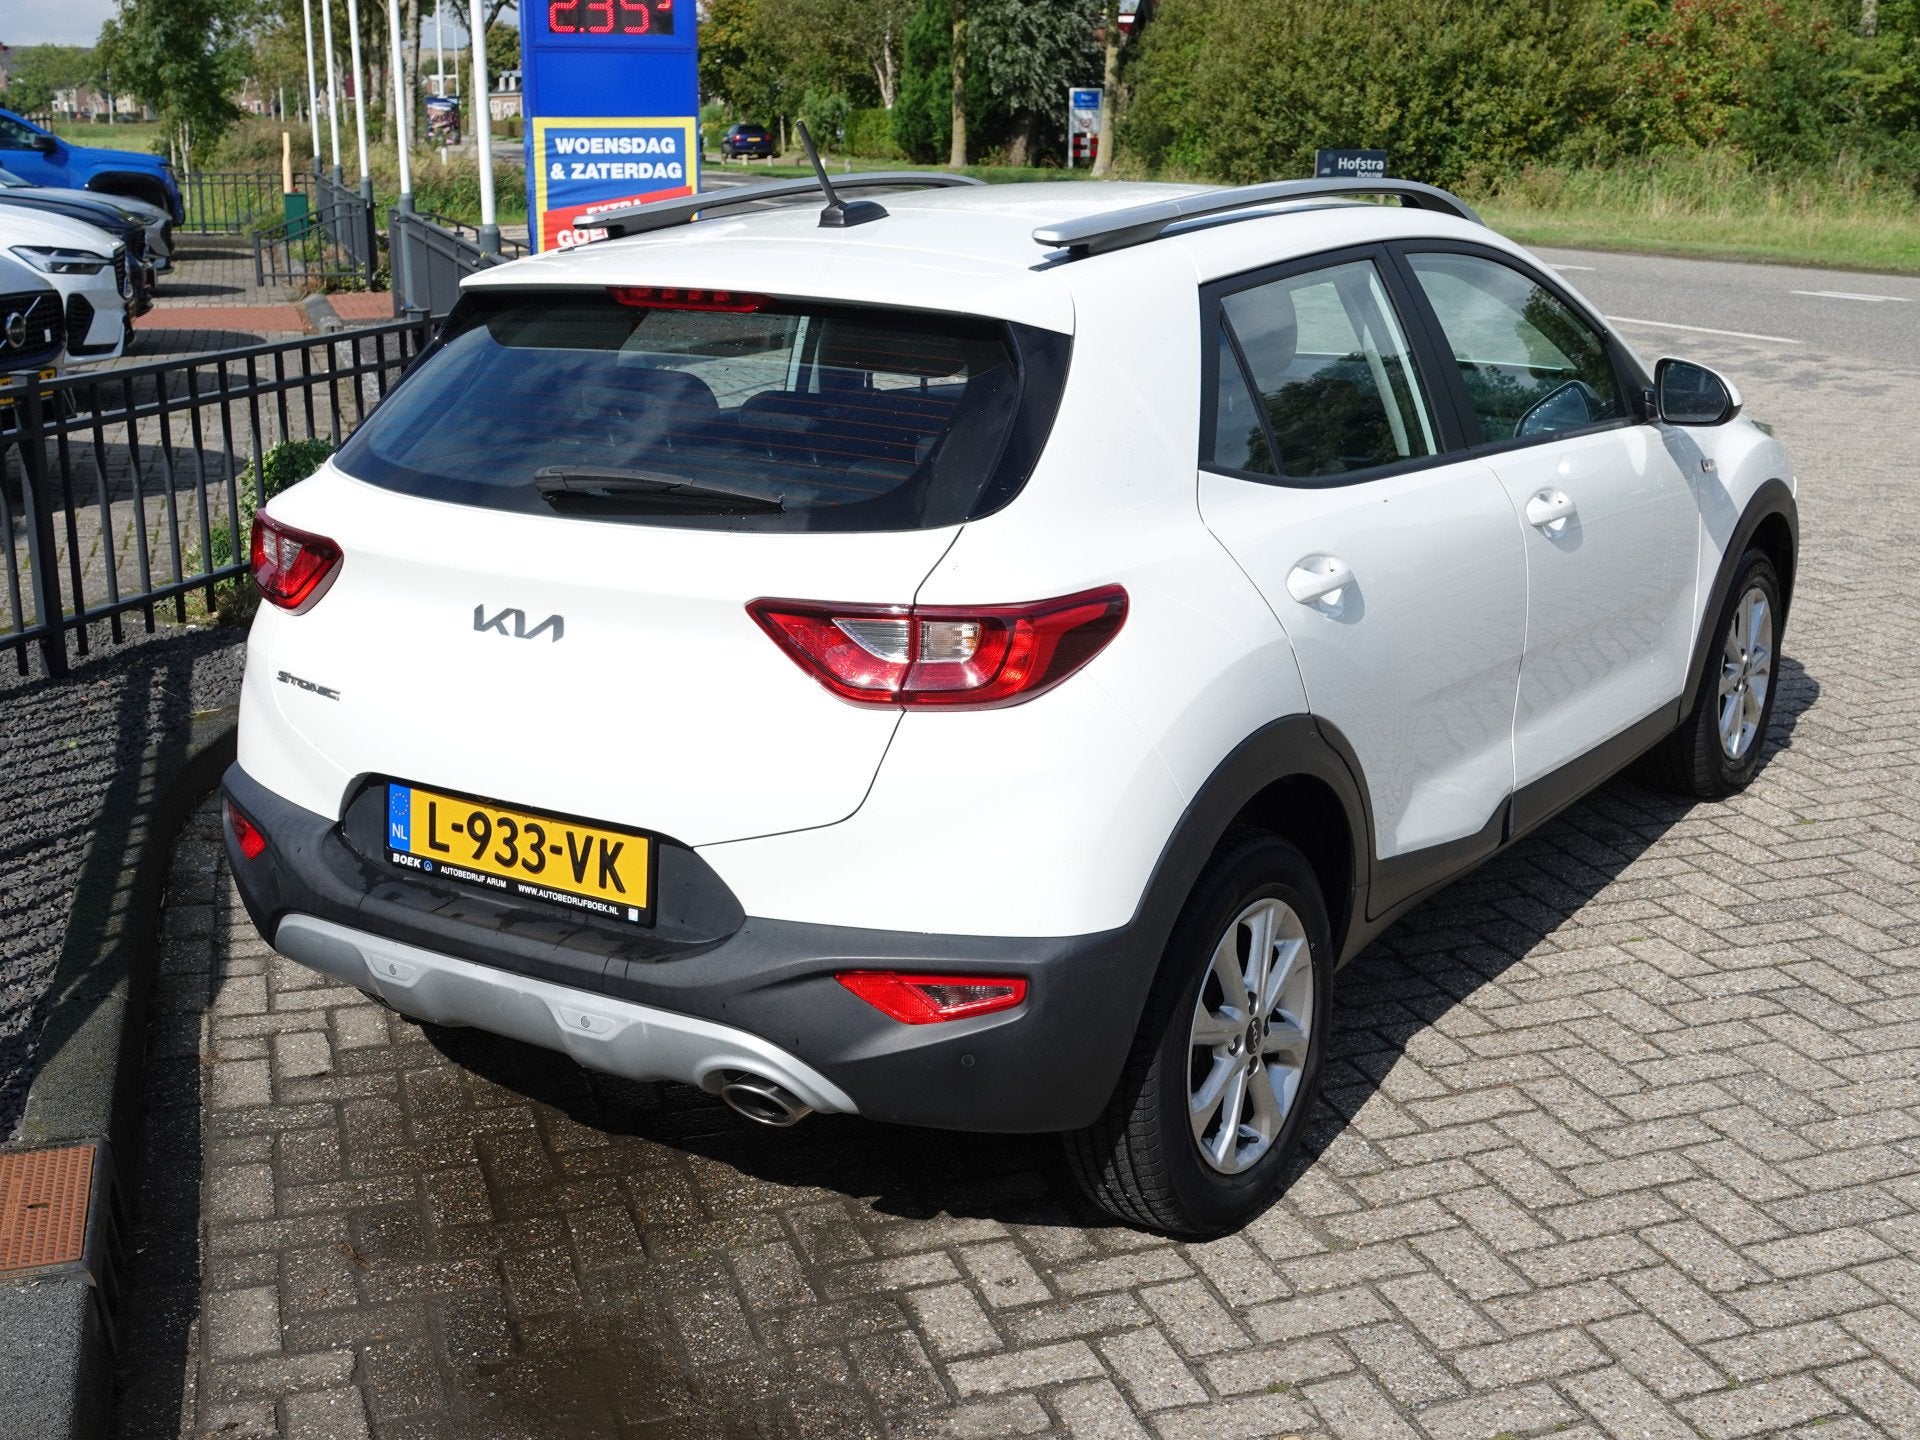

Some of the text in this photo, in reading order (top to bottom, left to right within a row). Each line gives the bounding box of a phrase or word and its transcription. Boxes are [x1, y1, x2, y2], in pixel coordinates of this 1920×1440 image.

[549, 0, 671, 33] 2.35
[555, 137, 676, 154] WOENSDAG
[550, 162, 682, 180] & ZATERDAG
[1338, 157, 1384, 170] Hofstra
[474, 603, 565, 643] KIA
[277, 670, 341, 701] STONIC
[392, 822, 408, 841] NL
[428, 801, 626, 894] L-933-VK
[392, 853, 421, 869] BOEK
[440, 865, 507, 889] AUTOBEDRIJF ARUM
[518, 883, 619, 916] WWW.AUTOBEDRIJFBOEK.NL
